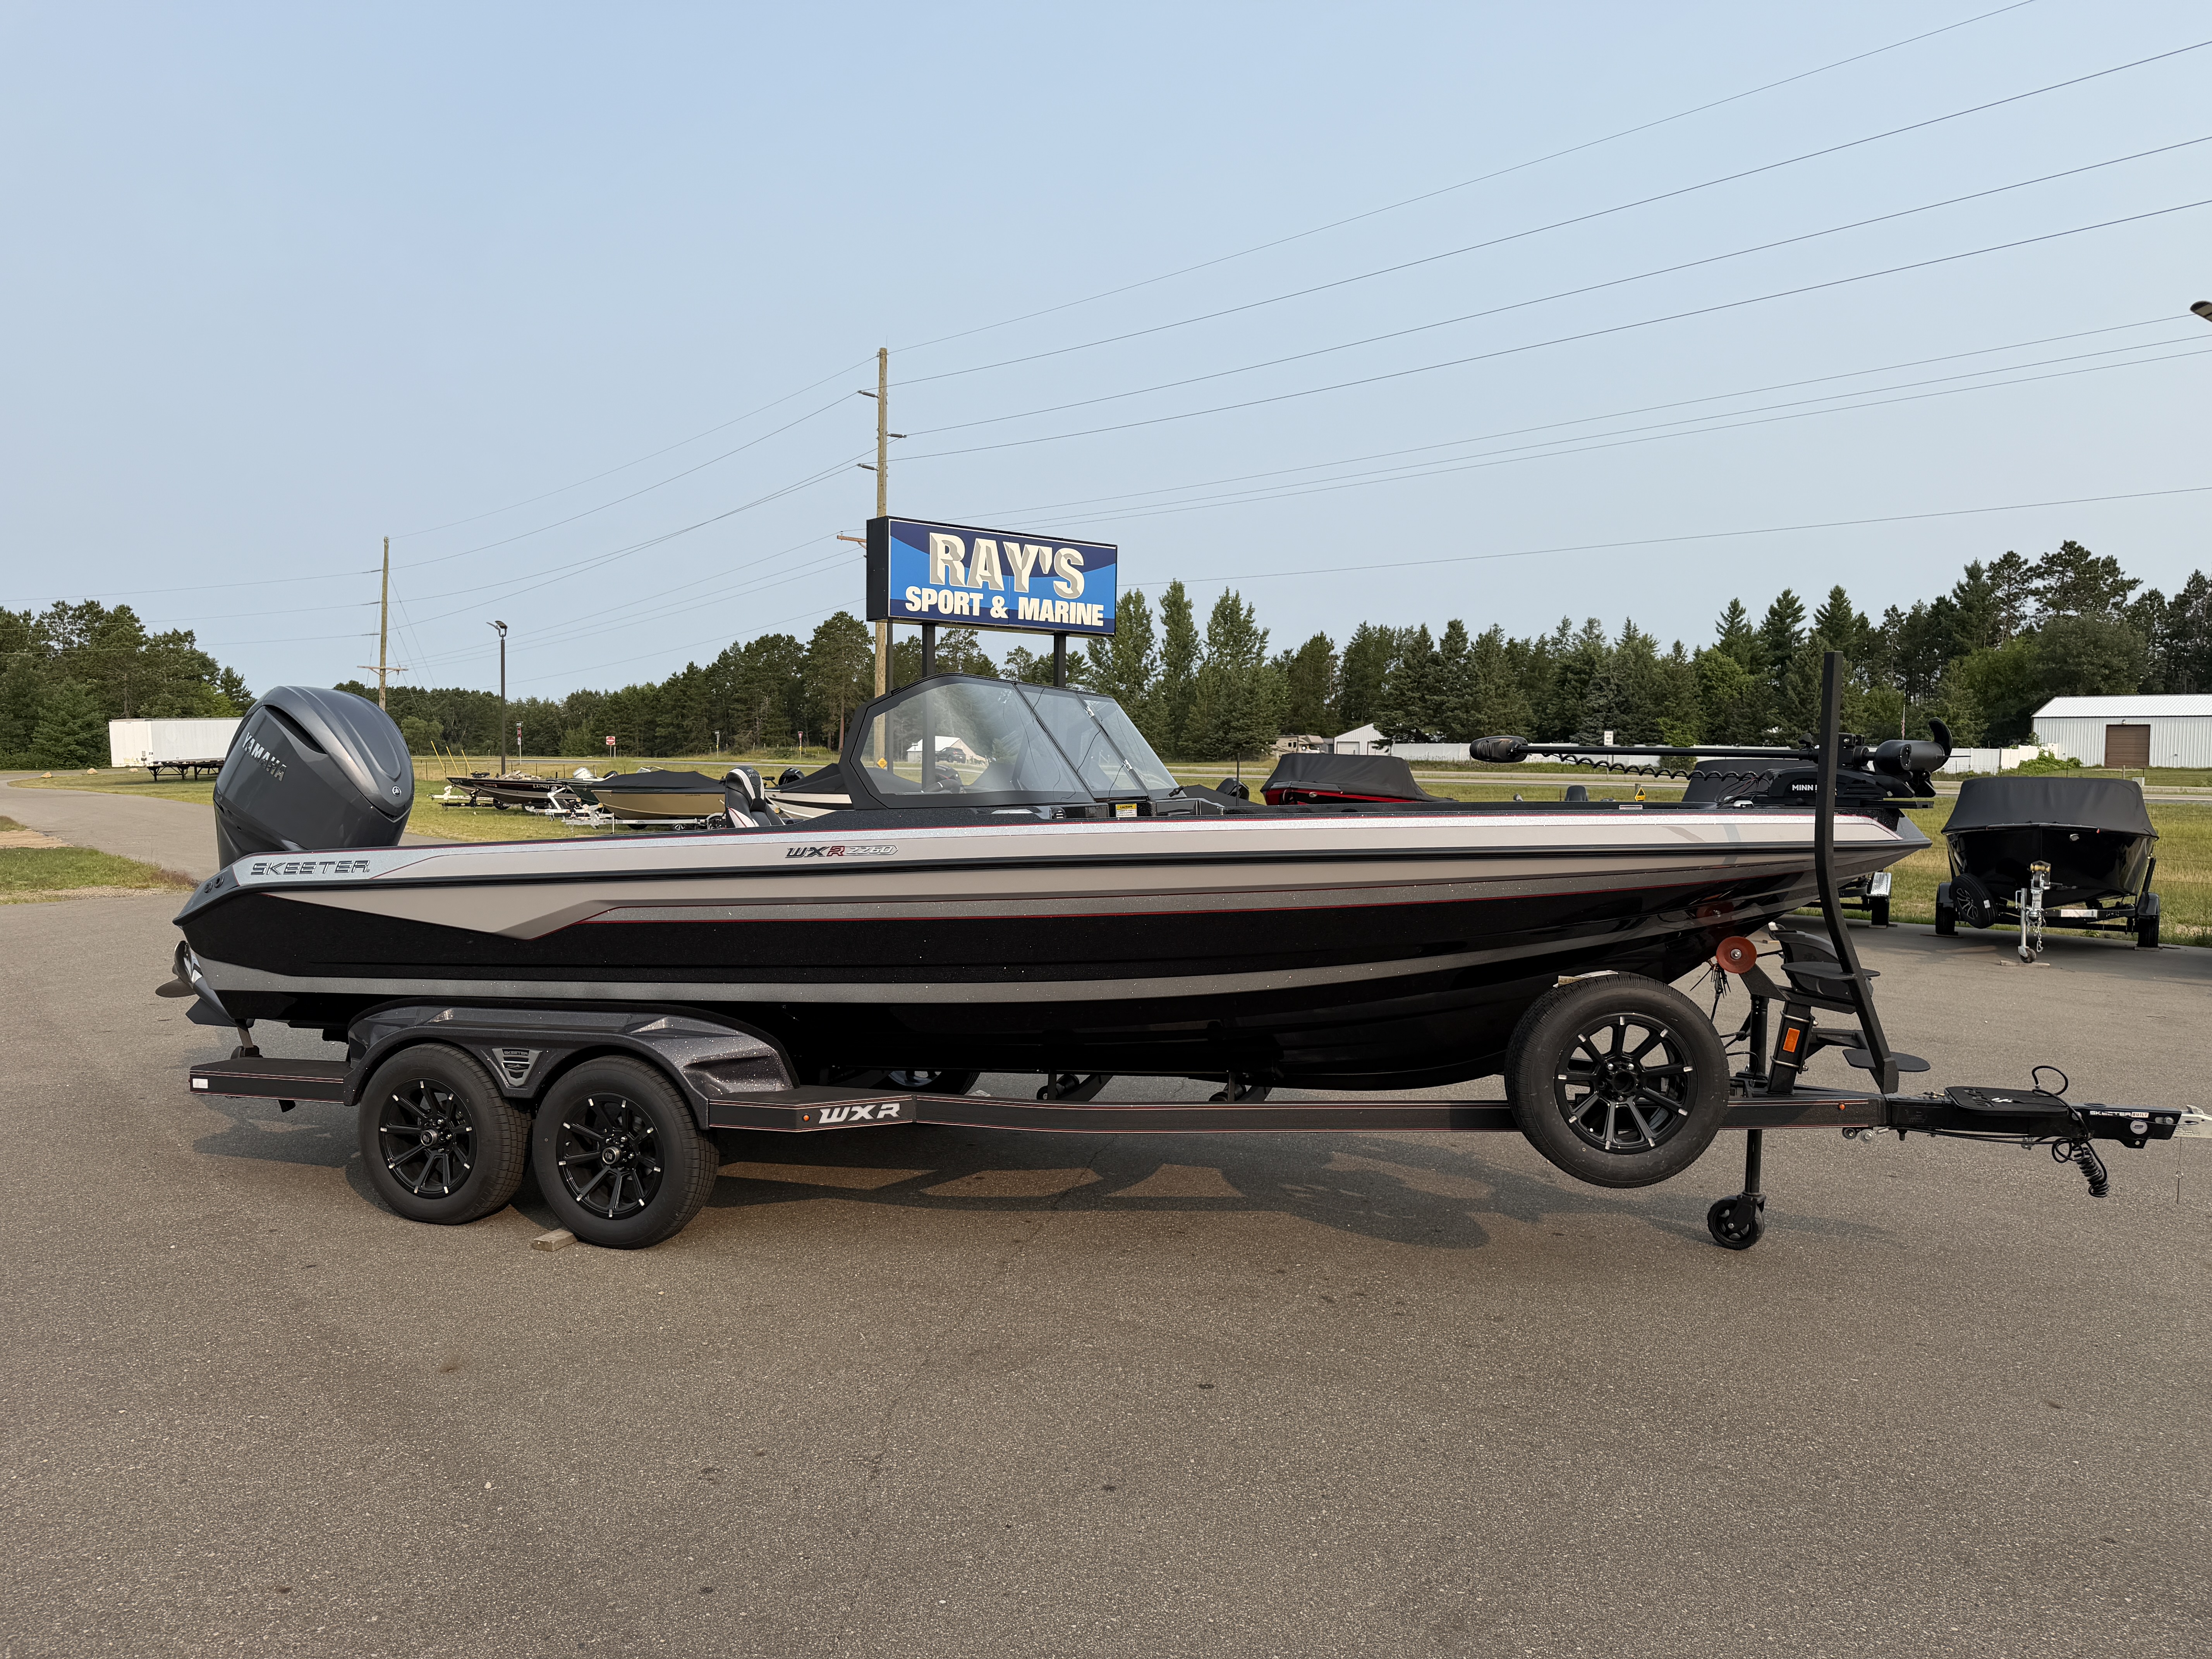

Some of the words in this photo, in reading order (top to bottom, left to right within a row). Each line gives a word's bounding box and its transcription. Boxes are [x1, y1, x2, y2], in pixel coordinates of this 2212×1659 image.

[929, 532, 1085, 599] RAY'S
[905, 586, 984, 616] SPORT
[990, 595, 1009, 619] &
[1018, 596, 1104, 626] MARINE
[242, 732, 287, 781] YAMAHA
[251, 860, 370, 875] SKEETER
[818, 1103, 901, 1124] WXR
